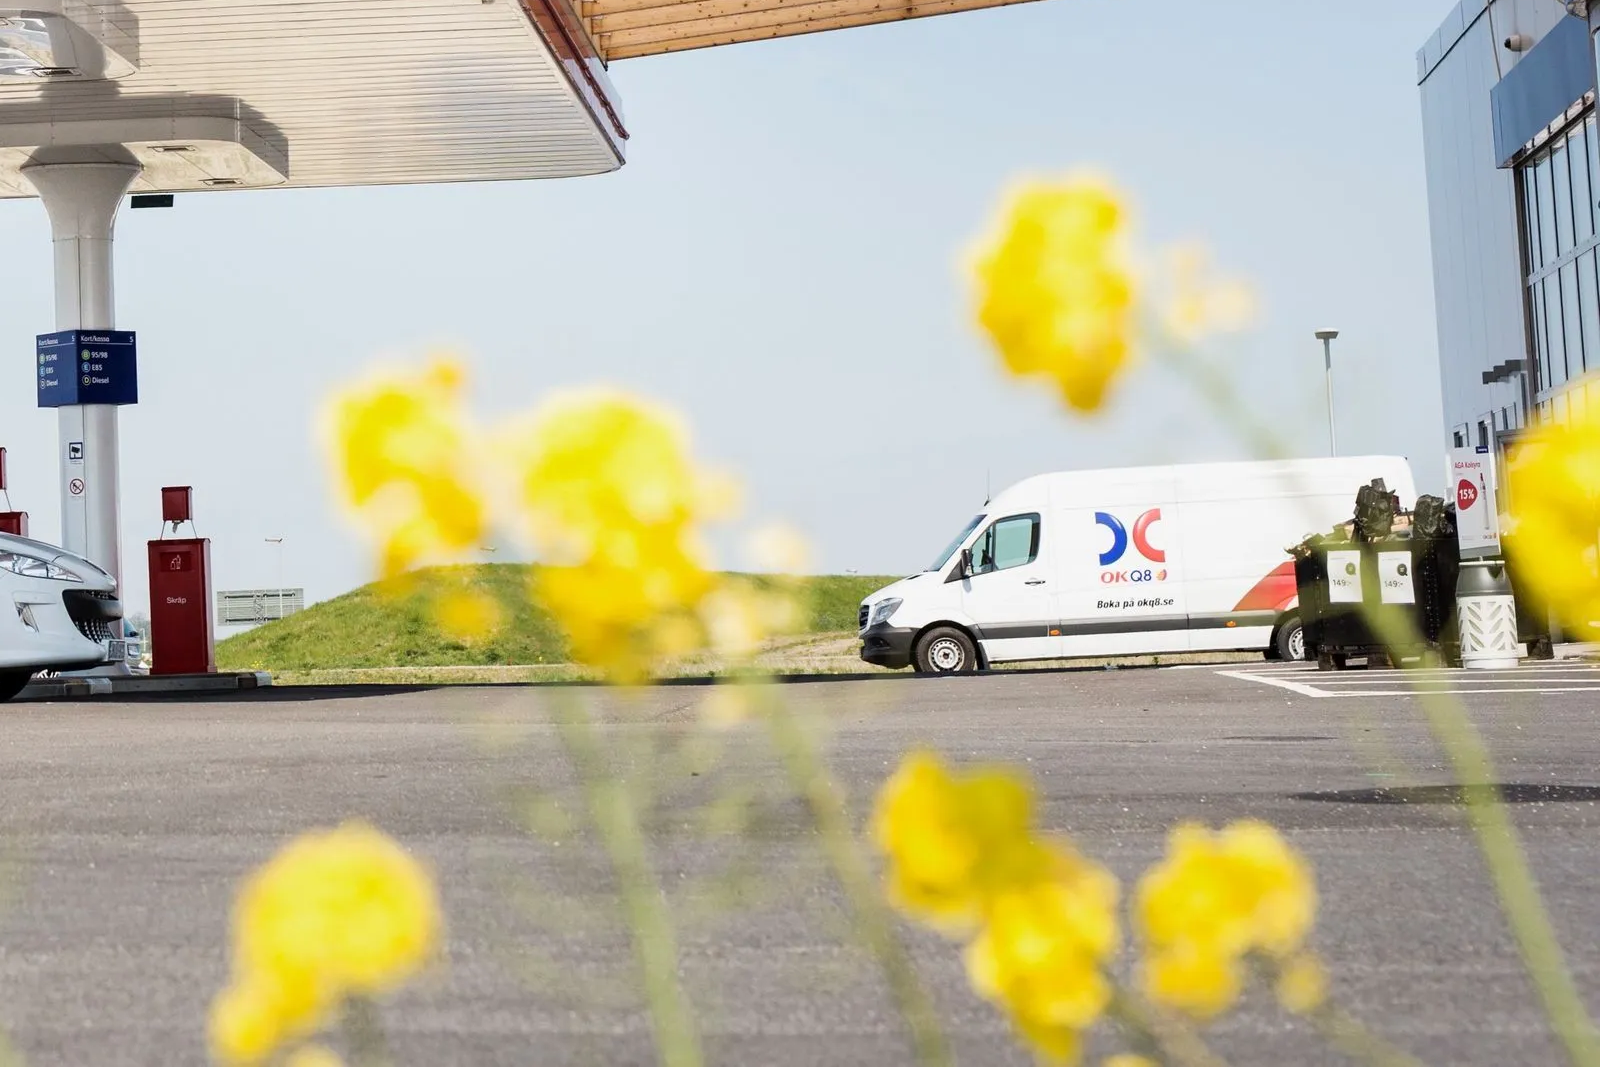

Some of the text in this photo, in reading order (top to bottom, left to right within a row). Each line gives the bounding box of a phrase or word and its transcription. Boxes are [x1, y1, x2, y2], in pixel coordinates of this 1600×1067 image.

[91, 351, 108, 359] 95/98
[1459, 489, 1475, 500] 15%
[166, 596, 187, 604] Skräp
[1097, 597, 1175, 610] Boka på okq8.se
